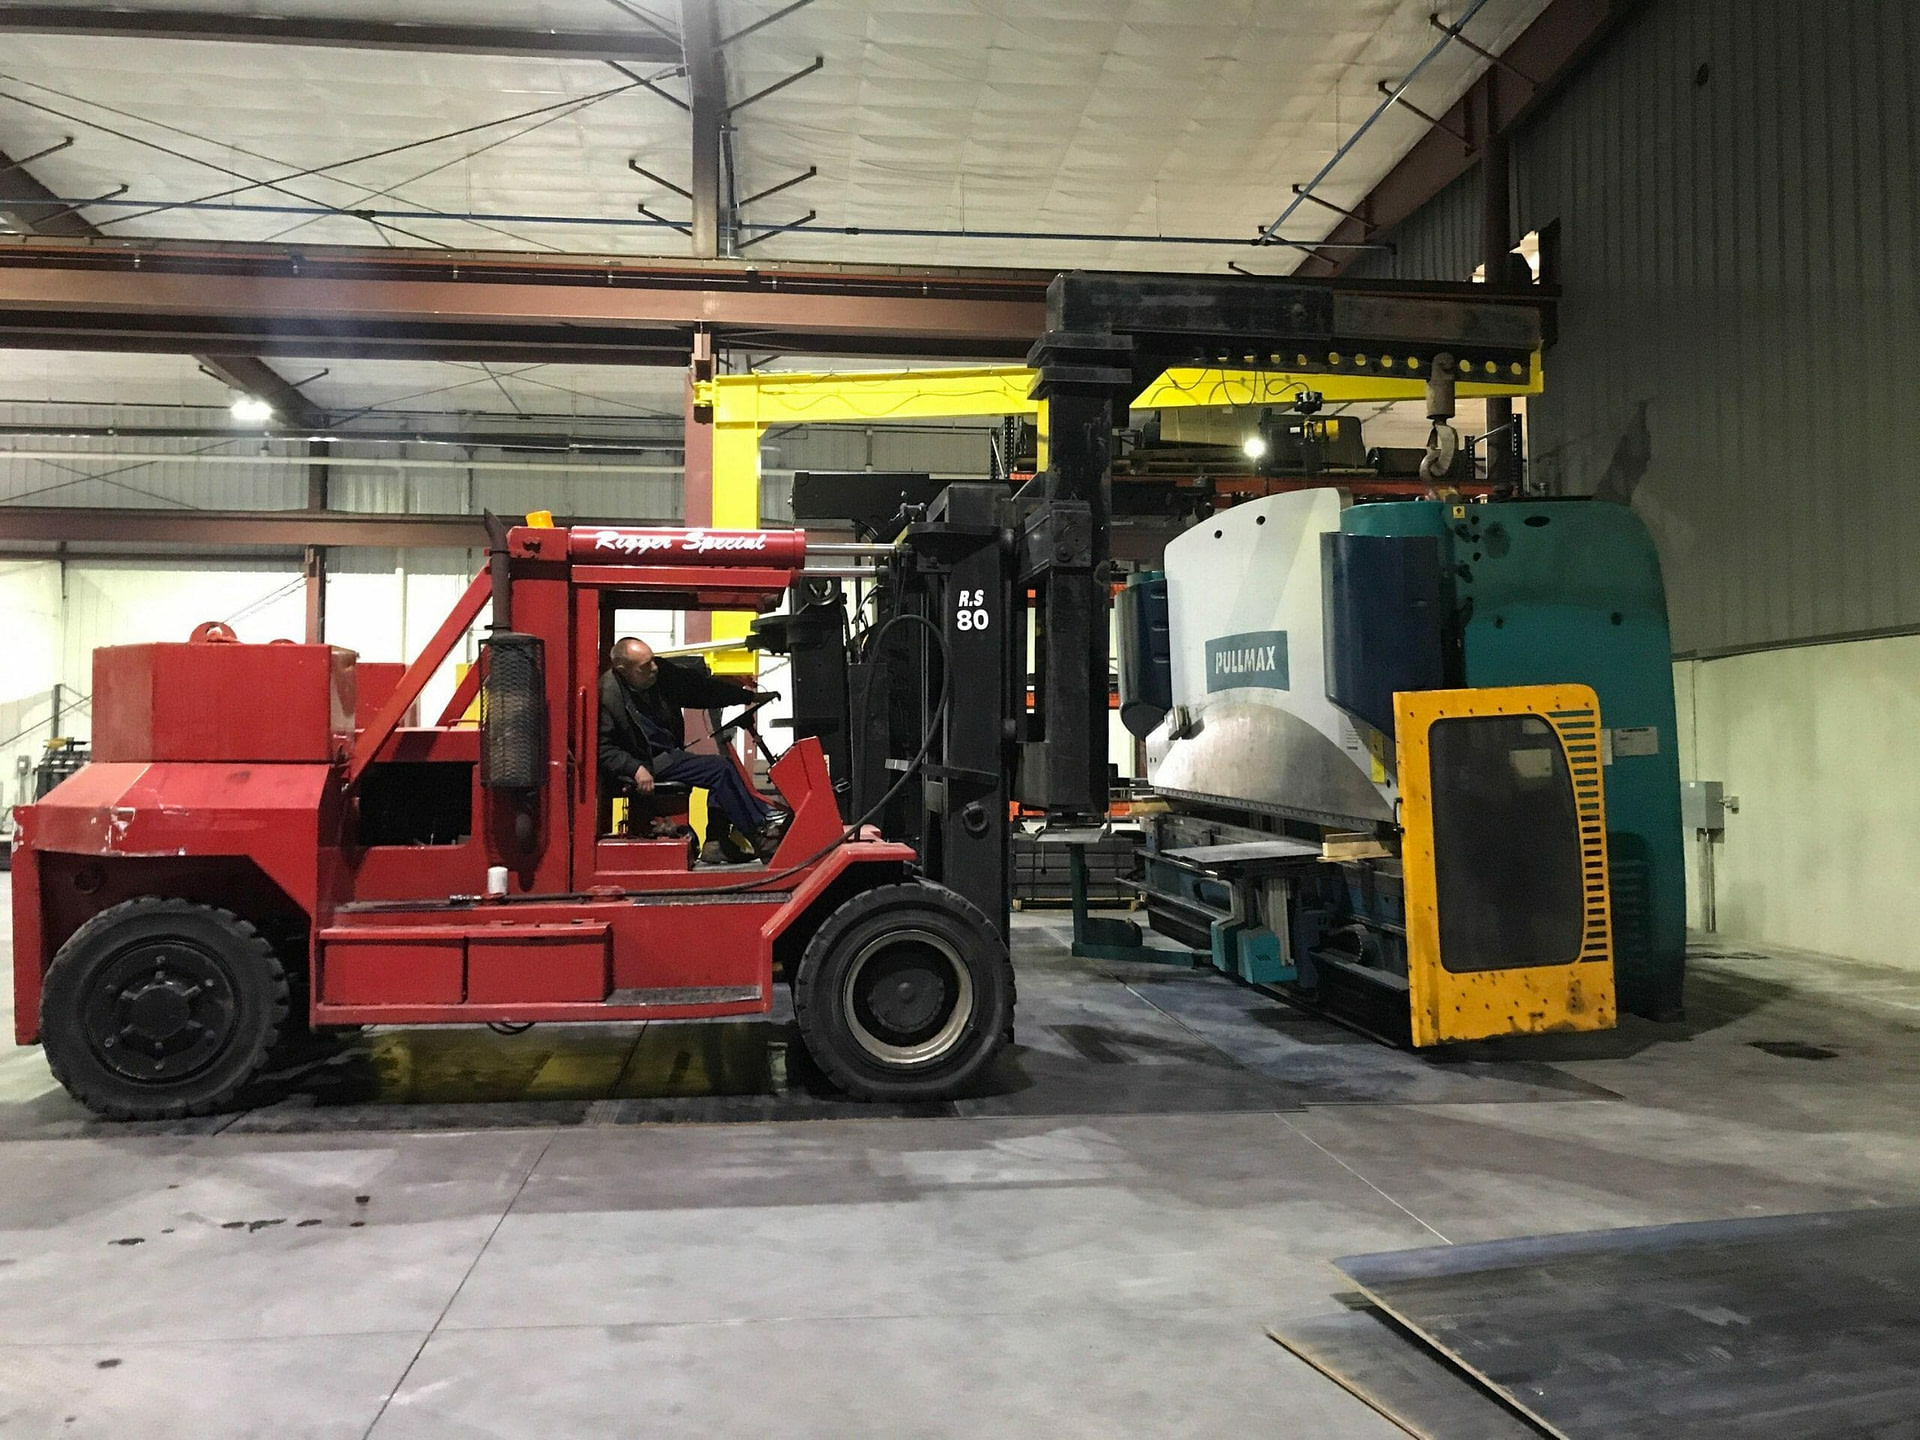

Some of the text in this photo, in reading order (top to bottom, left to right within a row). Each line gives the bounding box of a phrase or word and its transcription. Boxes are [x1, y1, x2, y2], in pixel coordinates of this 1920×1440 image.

[595, 530, 767, 555] Rigger Special
[958, 589, 985, 607] R.S
[956, 609, 989, 631] 80
[1215, 645, 1276, 675] PULLMAX
